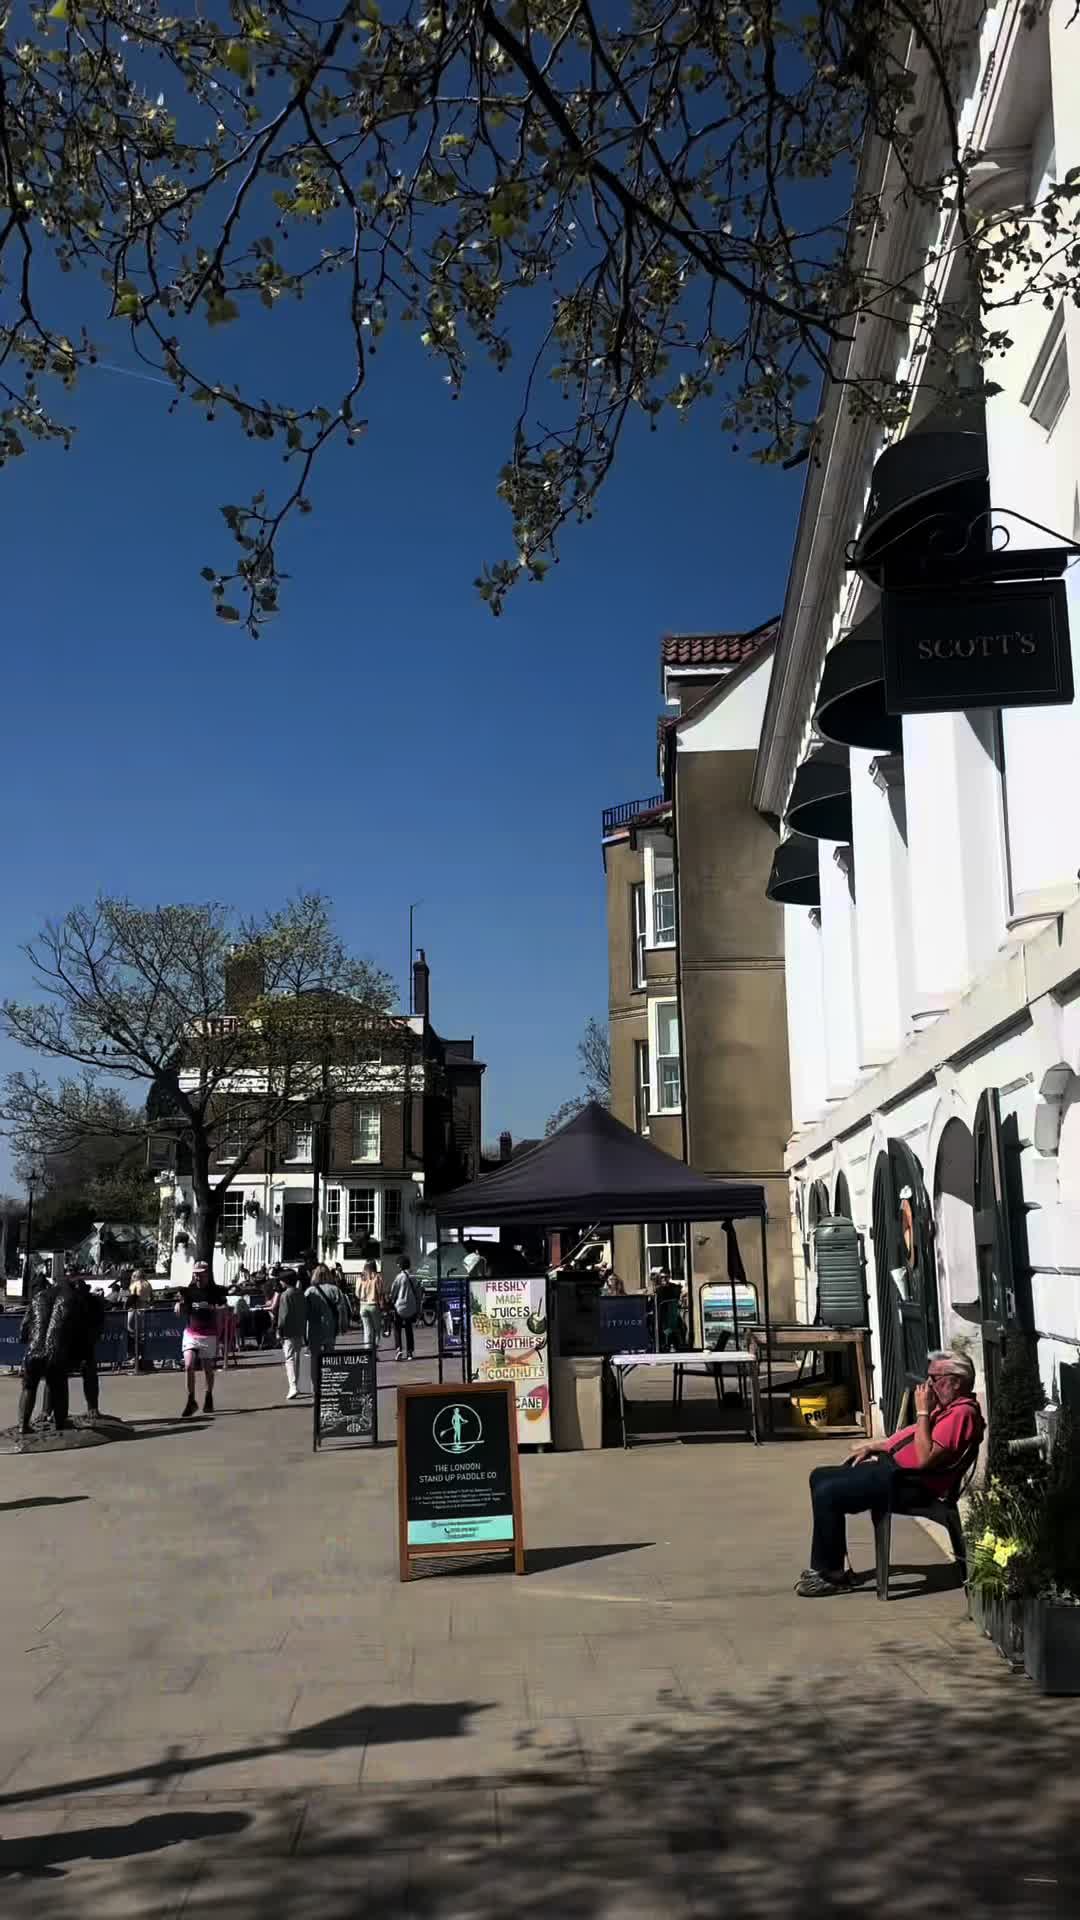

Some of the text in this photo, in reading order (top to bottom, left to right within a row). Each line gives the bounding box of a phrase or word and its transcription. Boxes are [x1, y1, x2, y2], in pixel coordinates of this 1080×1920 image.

[918, 632, 1036, 659] SCOTT'S
[485, 1281, 527, 1292] FRESHLY
[495, 1294, 522, 1305] MADE
[490, 1306, 530, 1319] JUICES
[485, 1336, 544, 1350] SMOOTHIES
[343, 1355, 368, 1365] VILLAGE
[487, 1366, 545, 1379] COCONUTS
[435, 1462, 481, 1473] THE LONDON
[419, 1471, 497, 1483] STAND UP PADDLE CO
